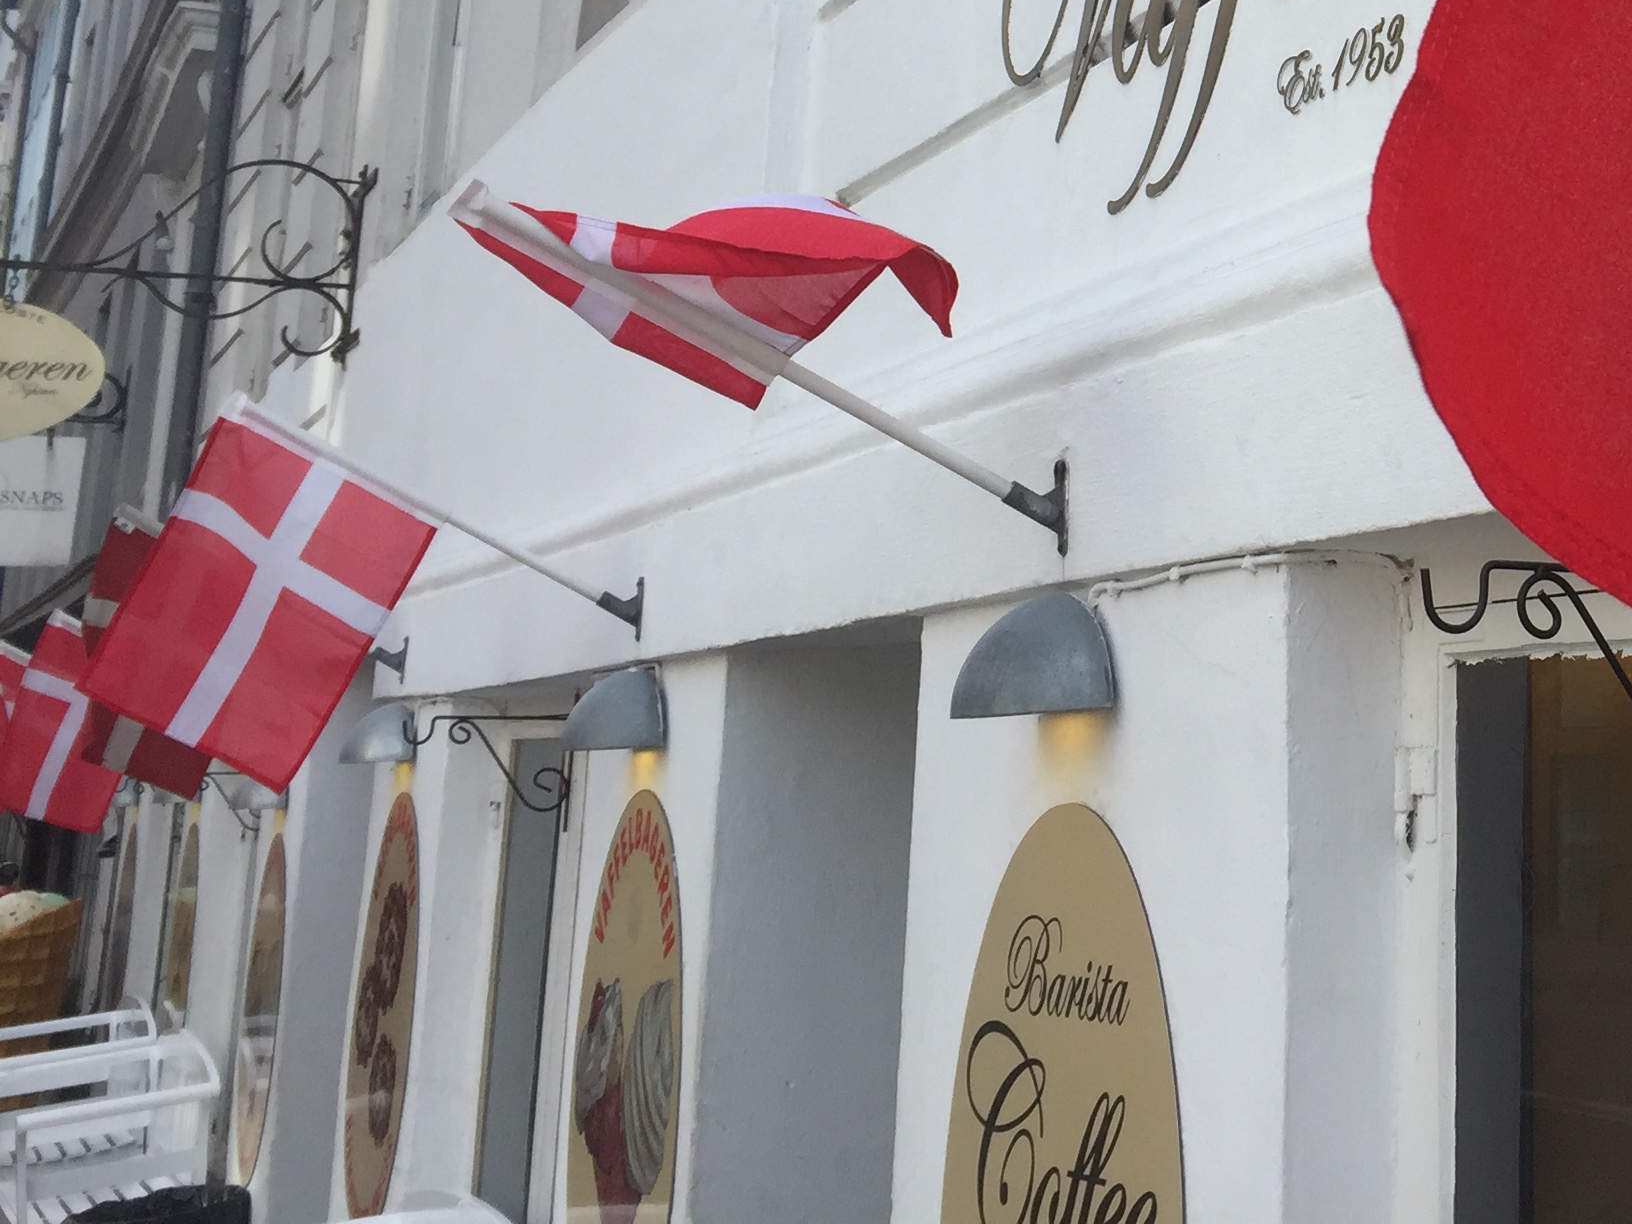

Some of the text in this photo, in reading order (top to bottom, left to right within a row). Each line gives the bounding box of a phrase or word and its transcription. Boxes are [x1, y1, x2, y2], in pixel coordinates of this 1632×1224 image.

[1276, 13, 1405, 115] Est. 1953
[595, 808, 675, 960] VAFFELBAGEREN
[1004, 914, 1131, 1026] Barista
